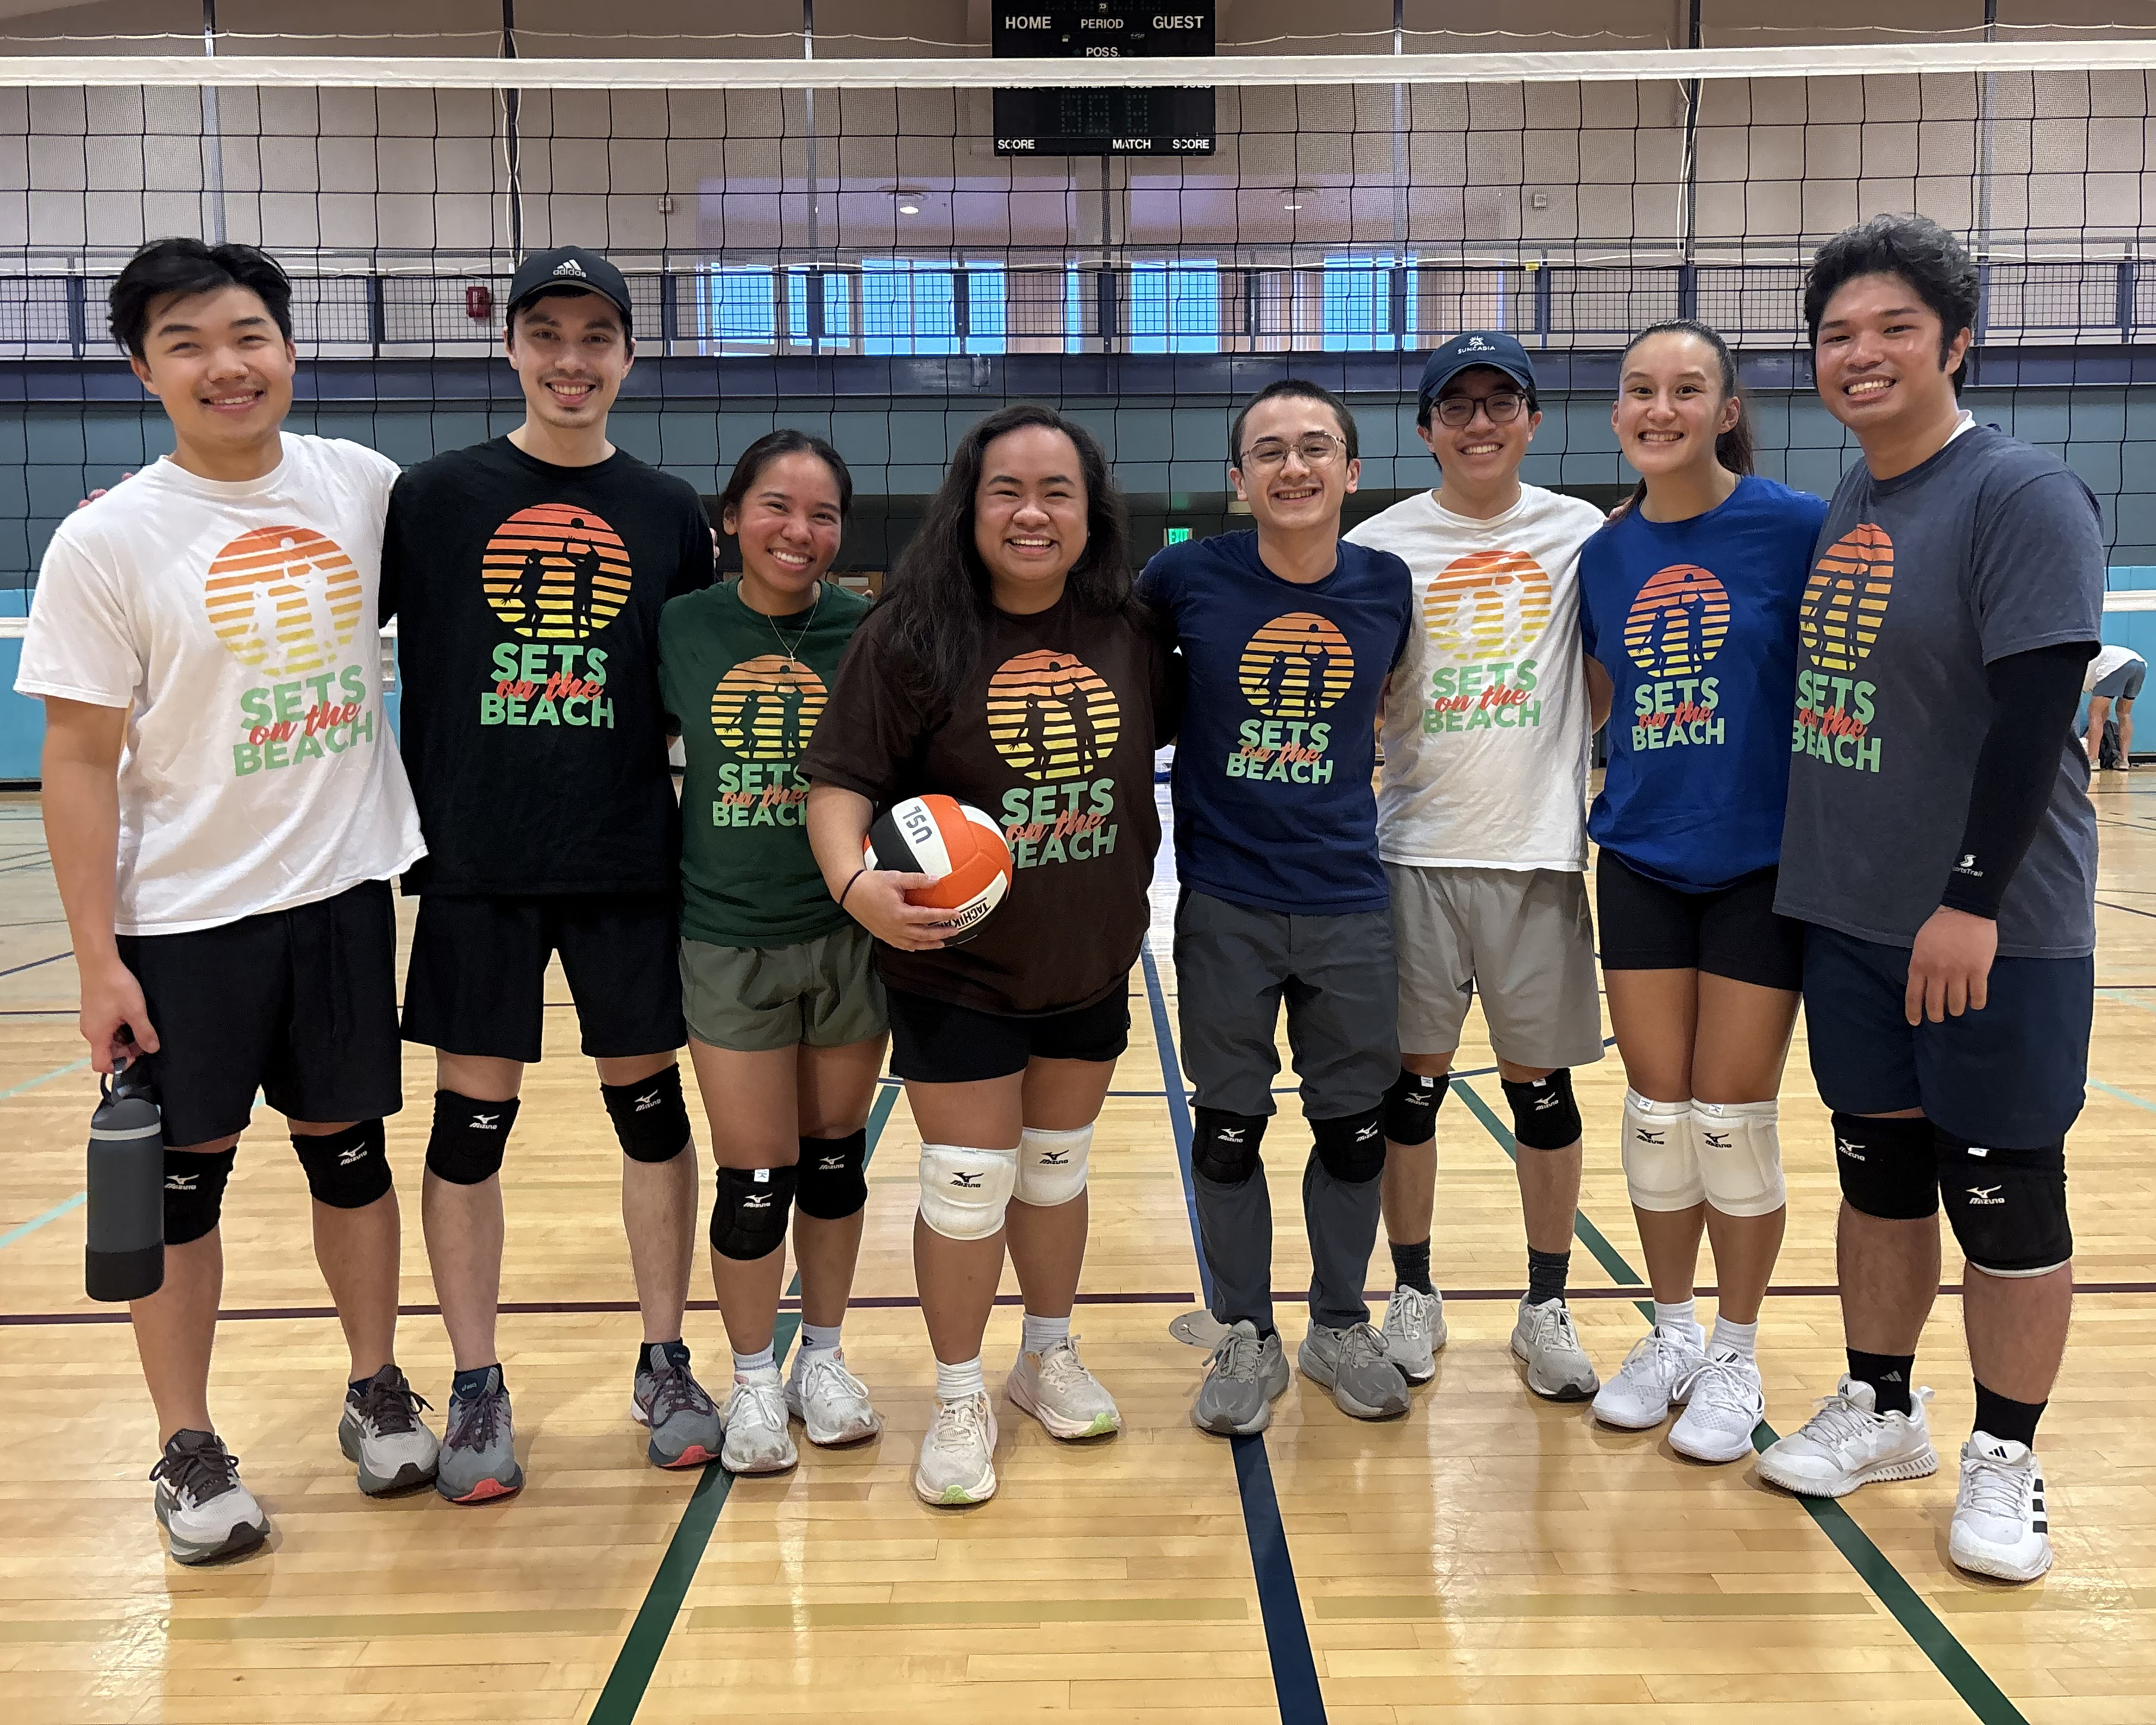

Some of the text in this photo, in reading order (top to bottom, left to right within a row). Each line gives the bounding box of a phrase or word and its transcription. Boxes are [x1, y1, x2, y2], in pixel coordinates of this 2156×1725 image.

[1005, 16, 1052, 29] HOME
[1081, 18, 1124, 29] PERIOD
[1153, 15, 1204, 29] GUEST
[1086, 47, 1121, 57] POSS.
[997, 139, 1035, 149] SCORE
[1112, 139, 1151, 149] MATCH
[1172, 139, 1210, 149] SCORE
[553, 268, 586, 278] adidas
[1457, 345, 1496, 355] SUNCADIA
[1169, 528, 1188, 544] EXIT
[490, 642, 608, 686] SETS
[1430, 659, 1537, 699] SETS
[240, 664, 366, 730] SETS
[496, 671, 604, 702] on the
[1435, 683, 1531, 713] on the
[1634, 676, 1719, 717] SETS
[1796, 669, 1876, 725] SETS
[249, 701, 361, 746] on the
[481, 692, 614, 729] BEACH
[1423, 700, 1542, 733] BEACH
[1639, 700, 1715, 729] on the
[1821, 705, 1868, 741] the
[233, 711, 373, 777] BEACH
[1237, 719, 1332, 753] SETS
[1631, 717, 1725, 751] BEACH
[1791, 719, 1881, 773] BEACH
[1226, 752, 1333, 785] BEACH
[1241, 741, 1323, 764] on the
[722, 784, 808, 808] on the
[999, 778, 1115, 826] SETS
[902, 805, 933, 844] USL
[1006, 808, 1106, 842] on the
[938, 902, 988, 927] TACHIKA
